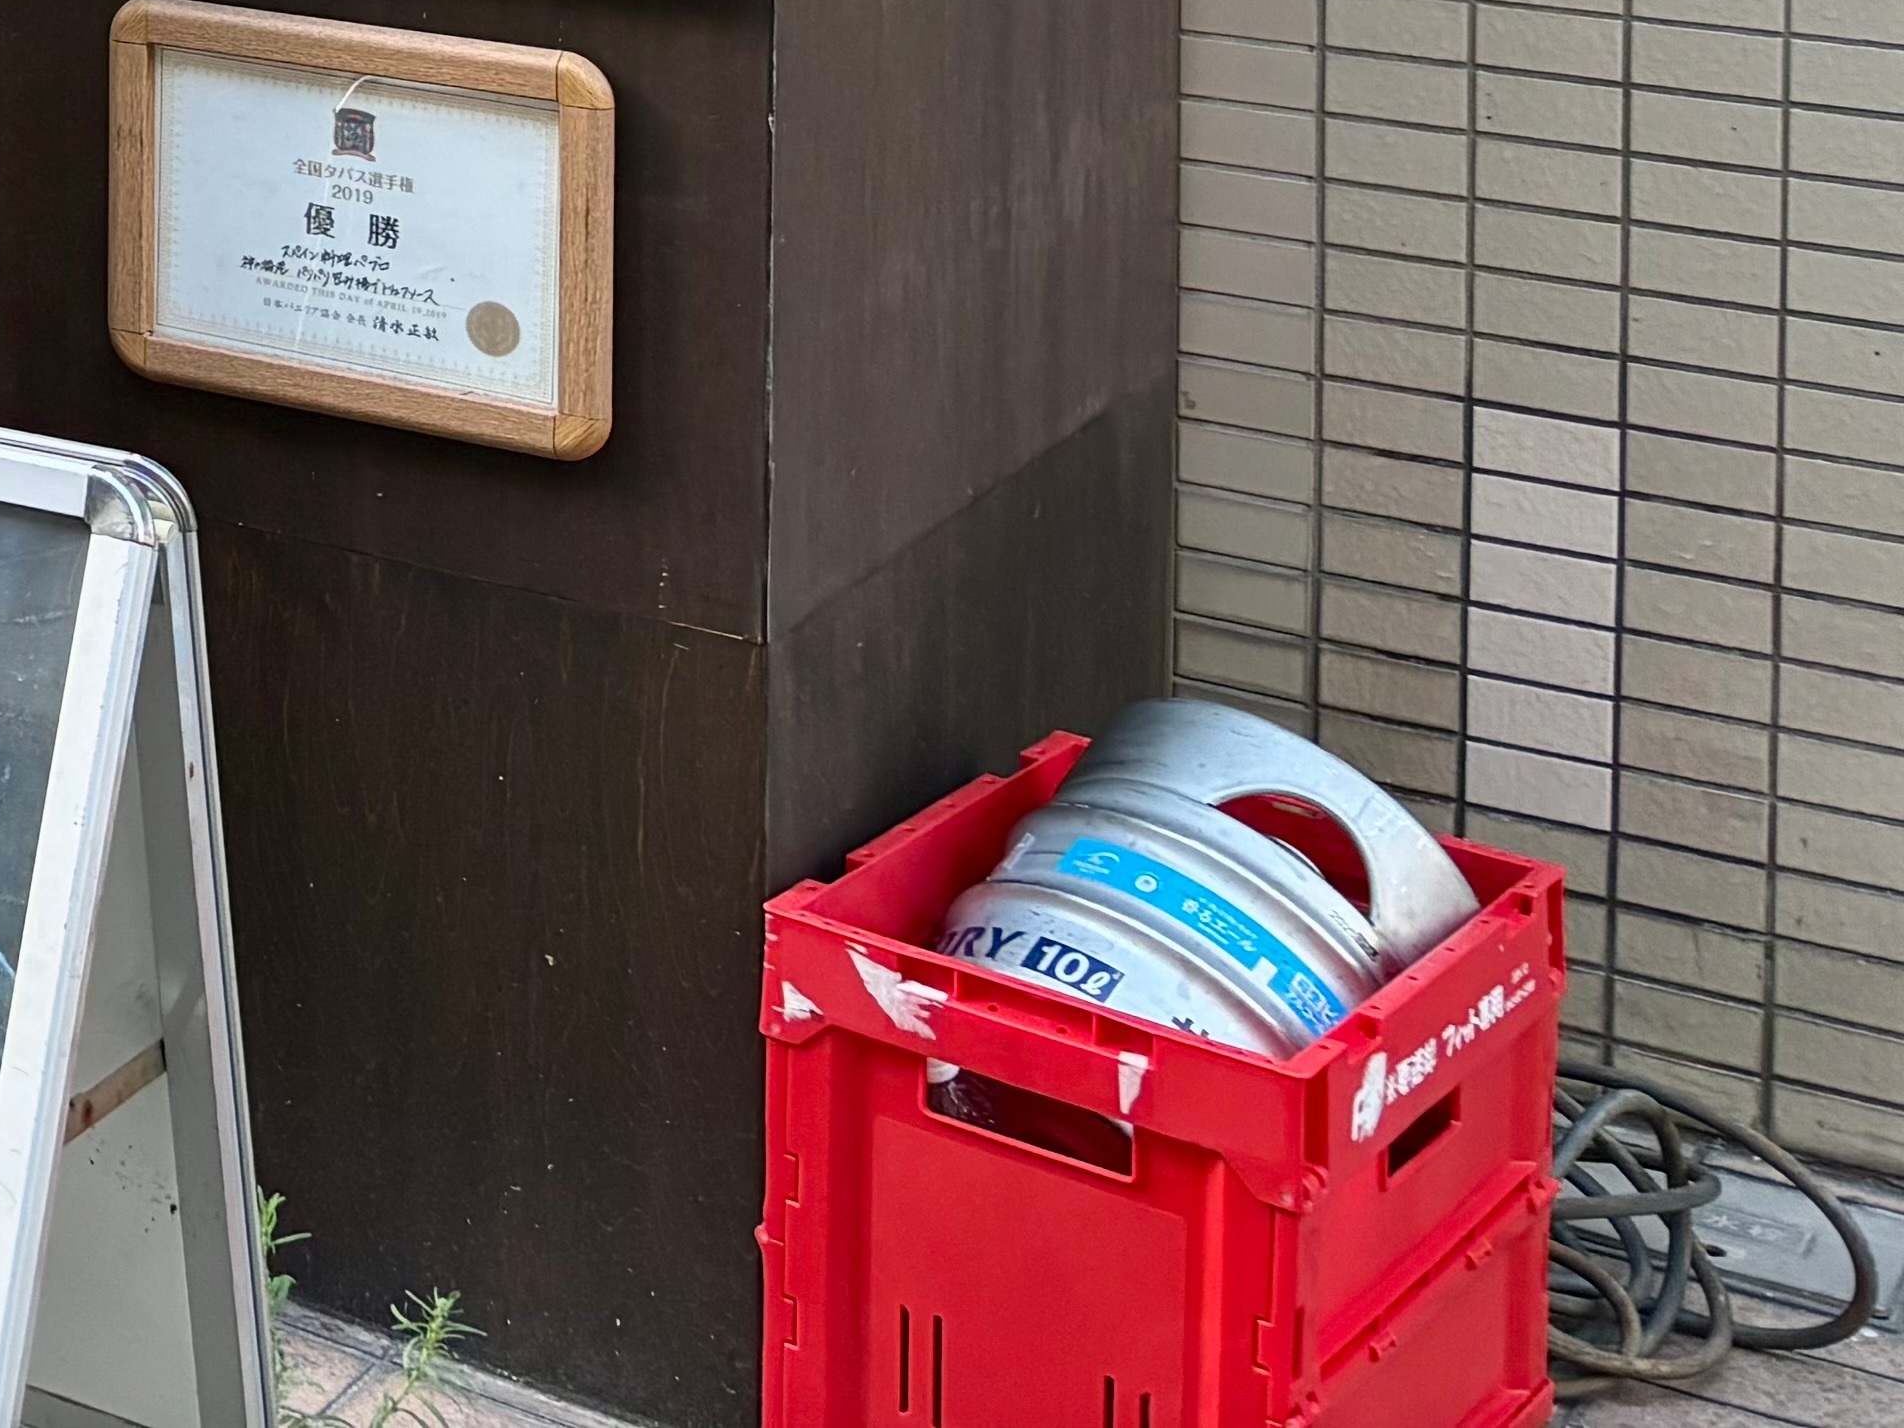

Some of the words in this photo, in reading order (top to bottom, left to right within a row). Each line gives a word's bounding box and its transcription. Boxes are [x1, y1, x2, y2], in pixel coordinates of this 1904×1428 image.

[292, 158, 415, 194] 全国タパス選手権
[331, 184, 374, 205] 2019
[255, 276, 309, 294] AWARDED
[311, 287, 336, 300] THIS
[338, 292, 360, 306] DAY
[376, 299, 408, 313] APRIL
